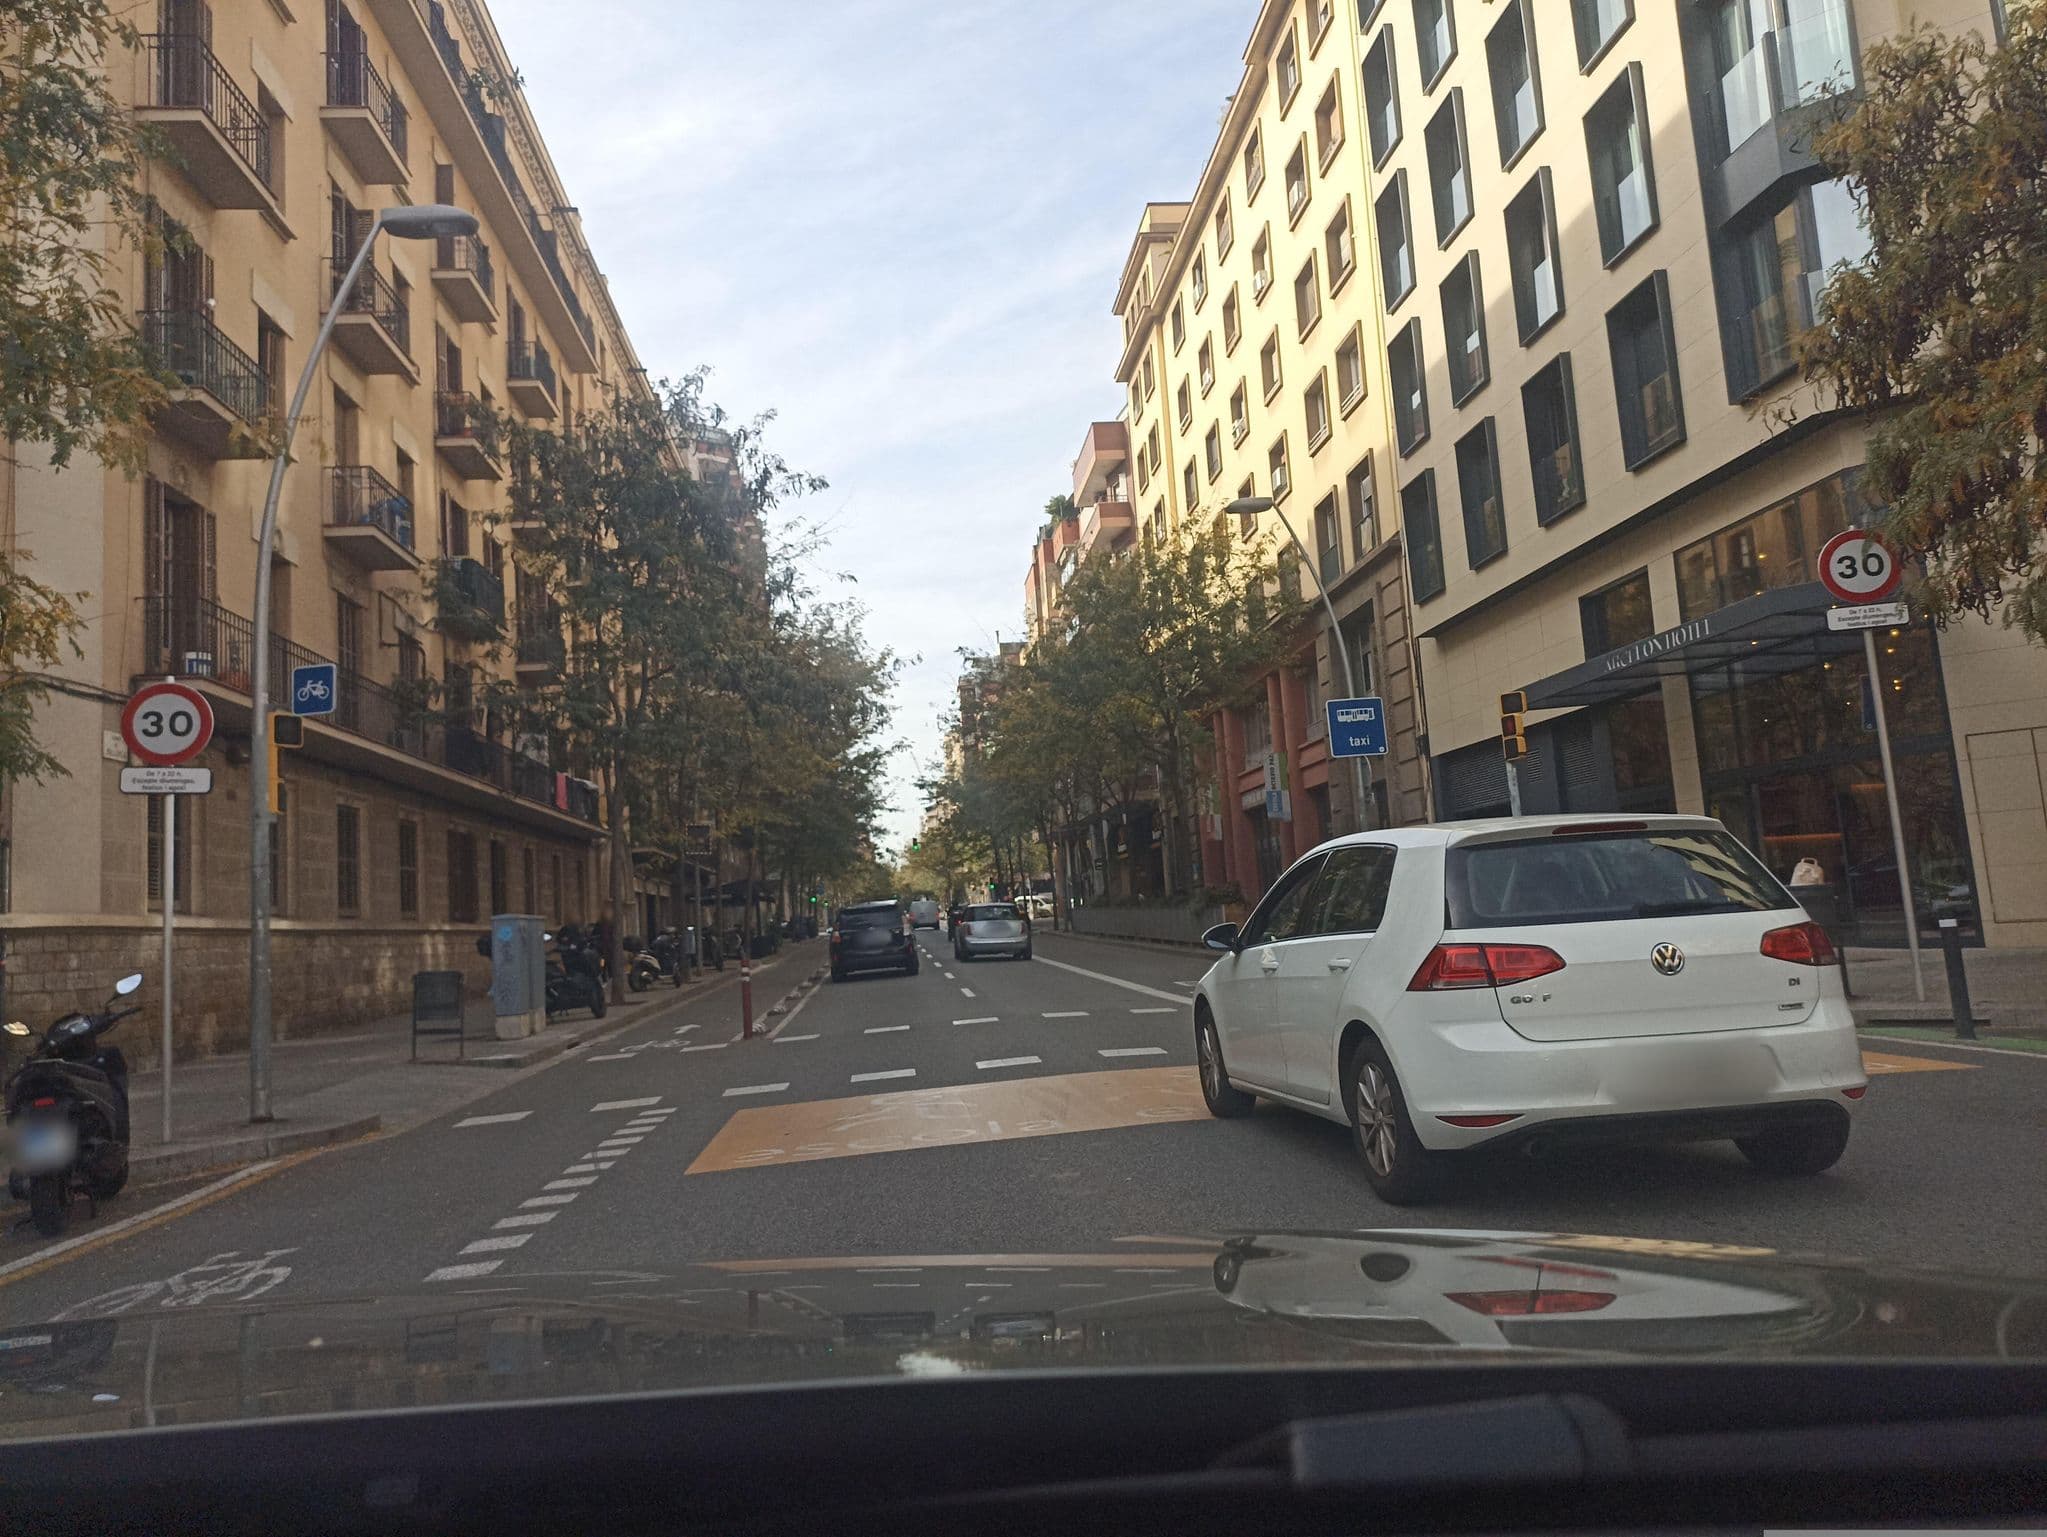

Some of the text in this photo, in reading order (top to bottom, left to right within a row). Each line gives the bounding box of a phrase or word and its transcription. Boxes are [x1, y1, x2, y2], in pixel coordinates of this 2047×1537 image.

[1836, 552, 1884, 579] 30
[142, 710, 193, 737] 30
[1349, 735, 1370, 747] taxi
[1510, 993, 1551, 1004] GOF
